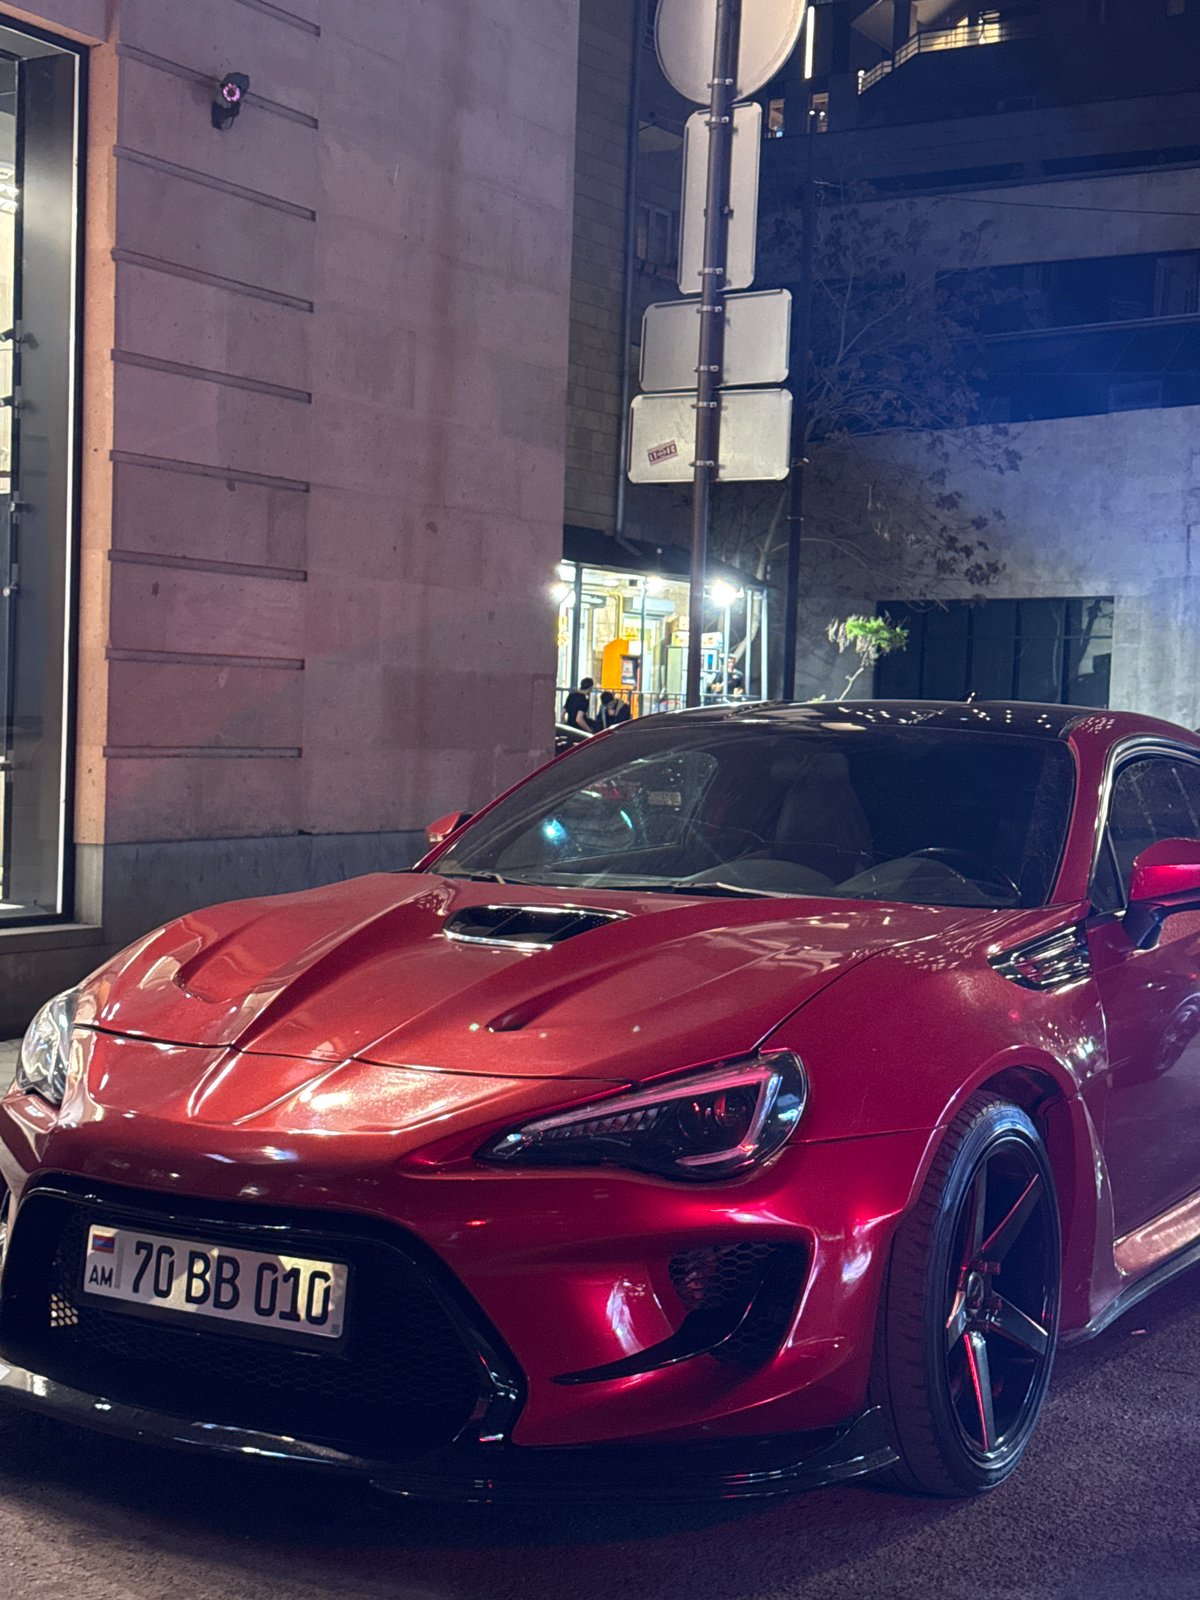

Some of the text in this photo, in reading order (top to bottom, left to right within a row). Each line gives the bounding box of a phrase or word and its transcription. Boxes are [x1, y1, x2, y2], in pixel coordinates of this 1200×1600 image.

[89, 1264, 114, 1288] AM
[132, 1240, 332, 1326] 70 BB 010
